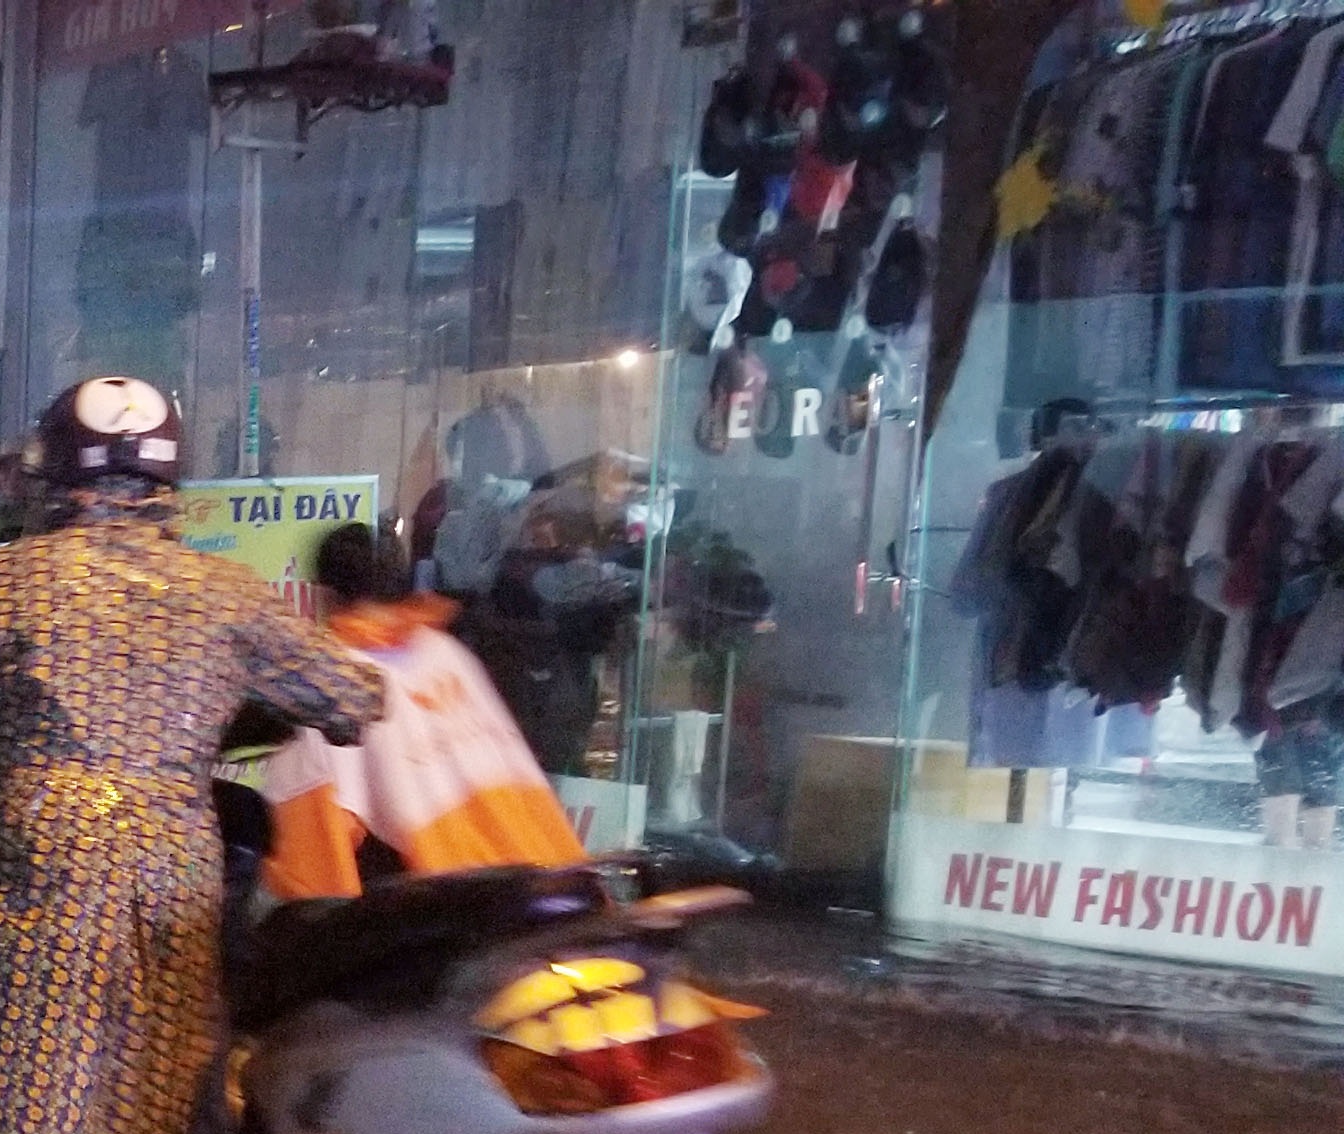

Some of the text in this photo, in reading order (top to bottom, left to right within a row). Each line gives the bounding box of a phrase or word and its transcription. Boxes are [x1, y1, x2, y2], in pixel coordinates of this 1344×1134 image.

[229, 488, 361, 527] TẠI ĐÂY
[944, 852, 1324, 947] NEW FASHION
